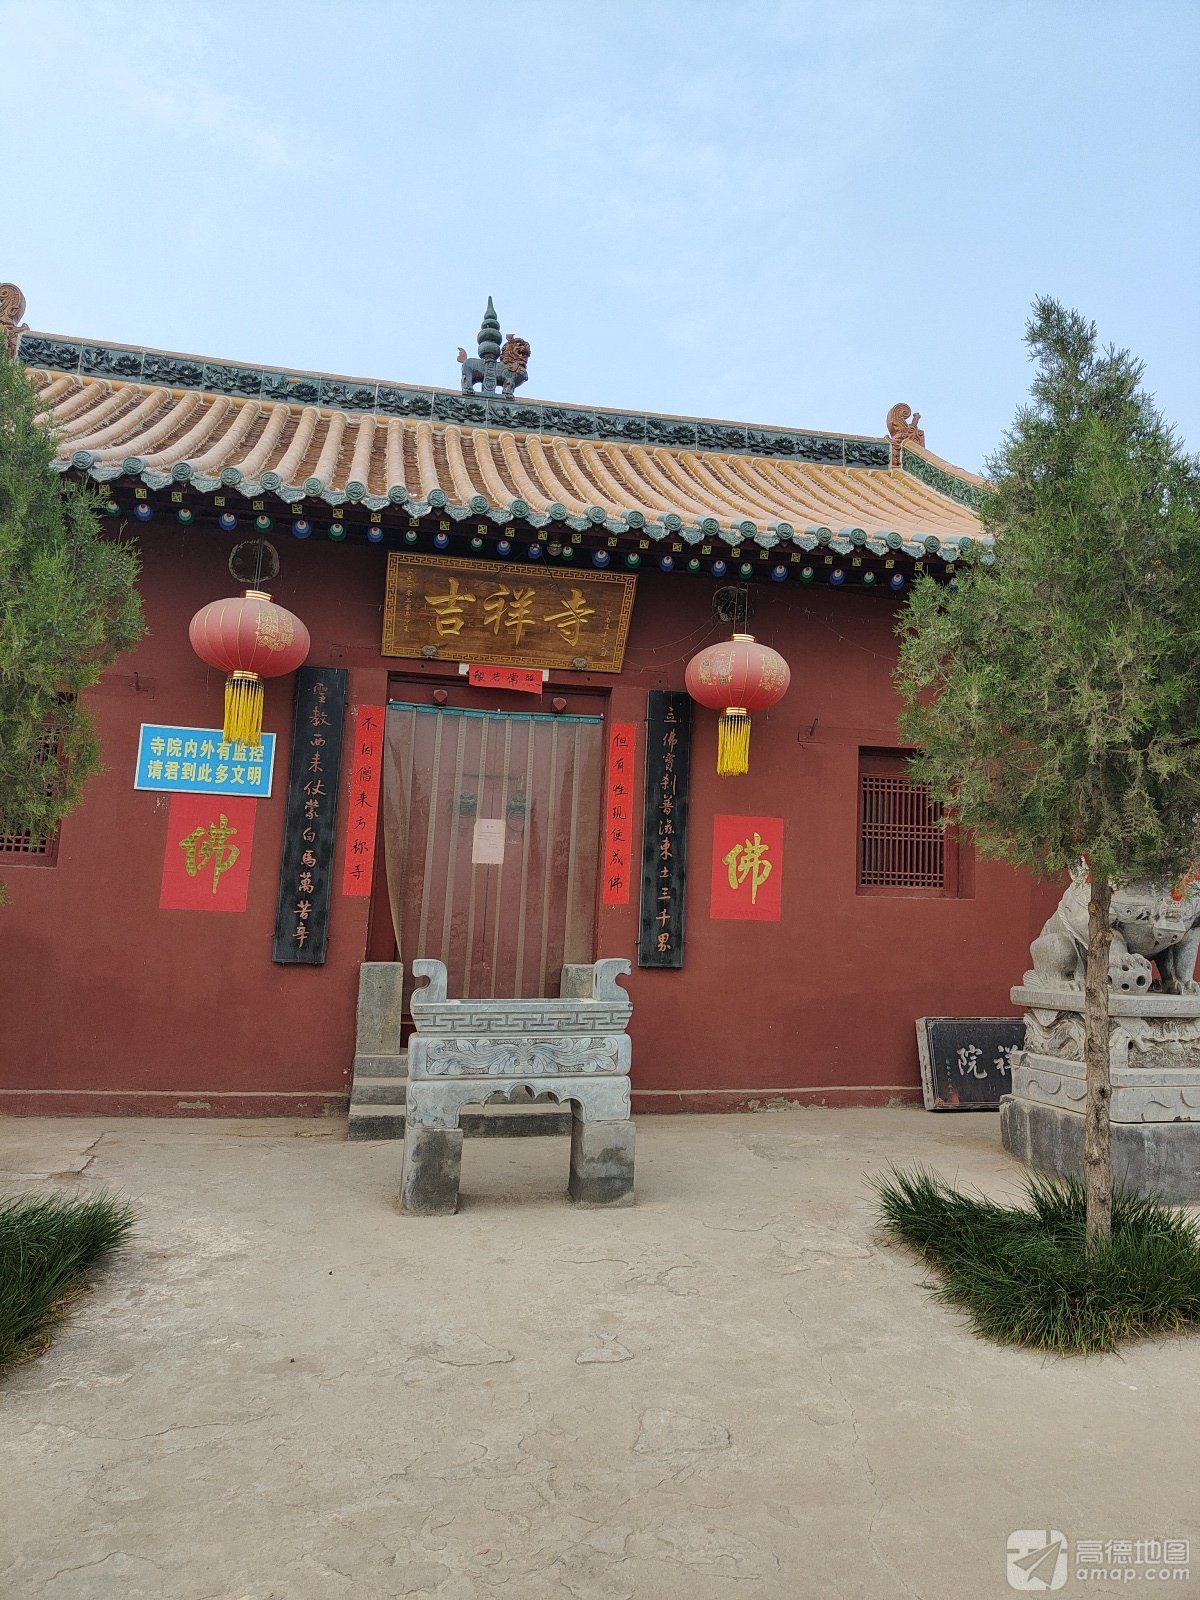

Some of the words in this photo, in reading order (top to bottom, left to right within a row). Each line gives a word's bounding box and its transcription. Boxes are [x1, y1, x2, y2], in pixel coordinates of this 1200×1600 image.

[424, 575, 597, 647] 吉祥寺
[147, 759, 263, 786] 请君到此多文明
[150, 736, 265, 763] 寺院内外有监控
[178, 813, 241, 894] 佛
[721, 831, 773, 905] 佛
